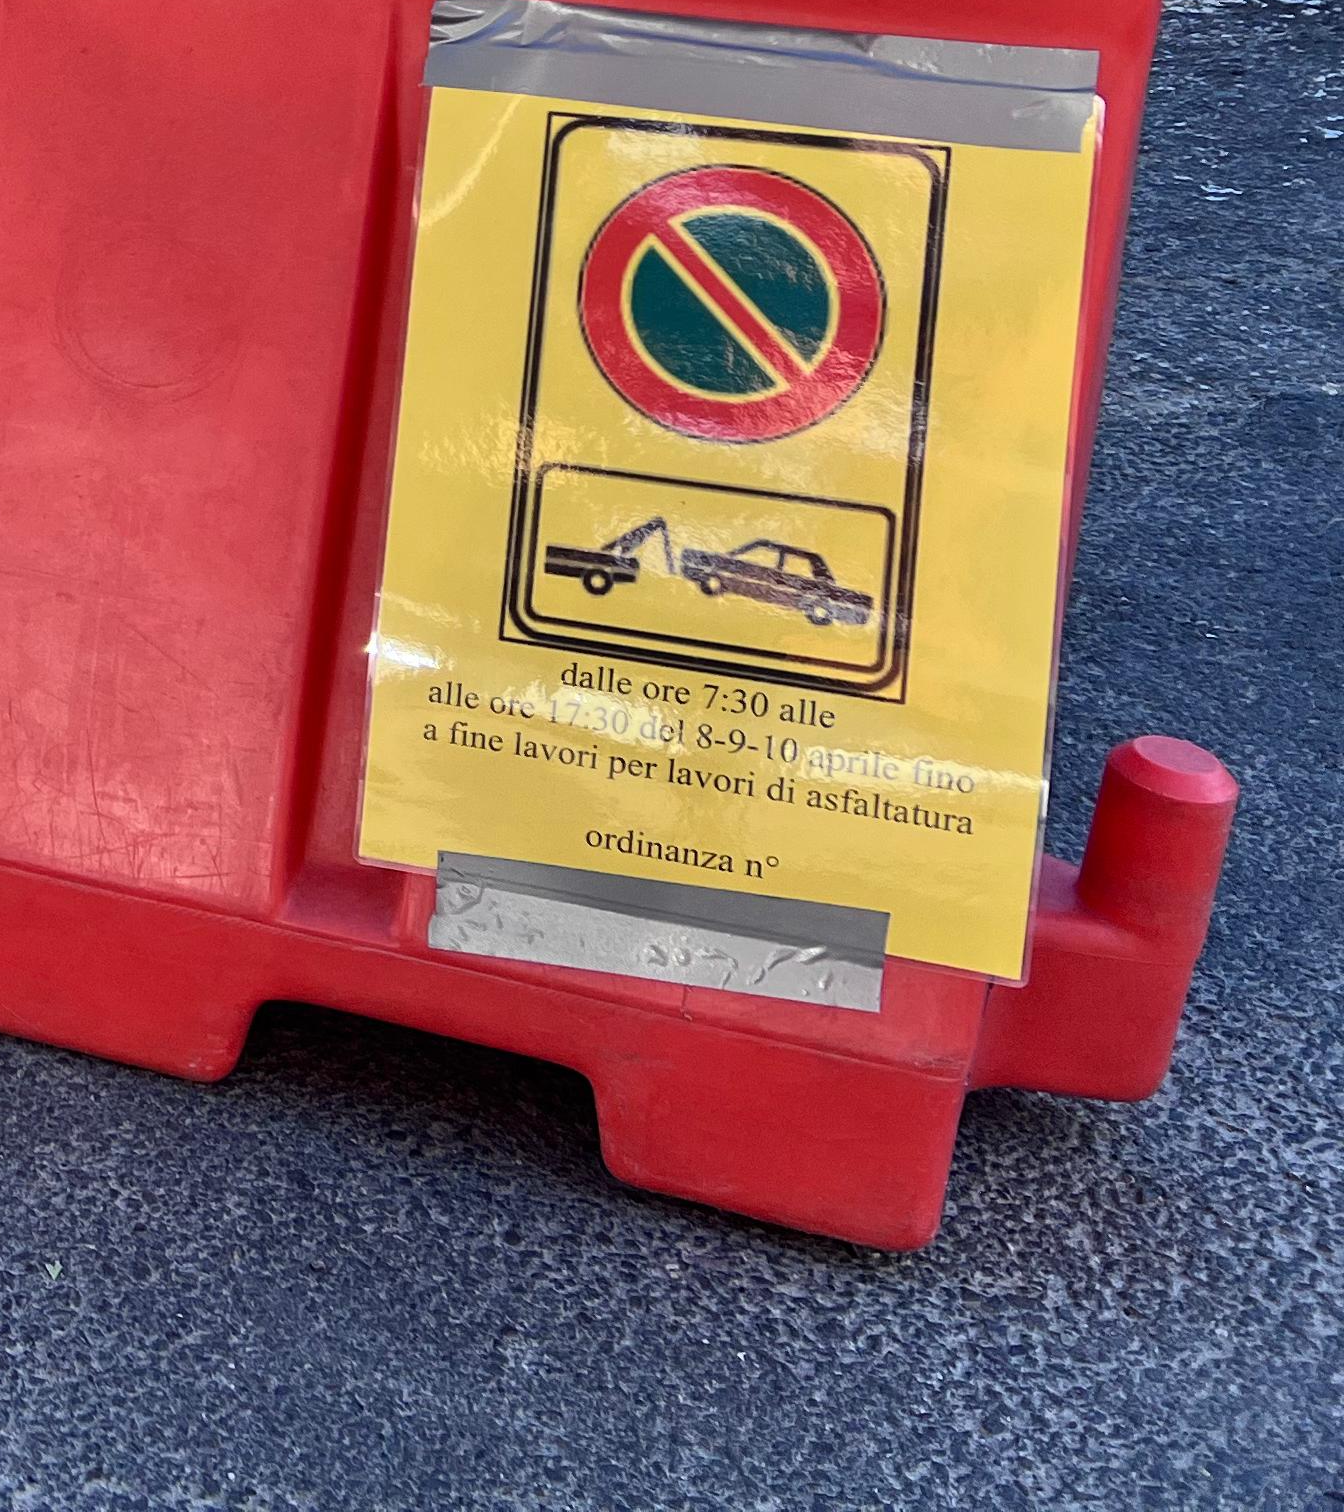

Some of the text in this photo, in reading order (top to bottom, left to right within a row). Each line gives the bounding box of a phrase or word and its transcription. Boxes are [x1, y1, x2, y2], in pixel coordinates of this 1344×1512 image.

[428, 681, 975, 794] alle ore 17:30 del 8-9-10 aprile fino
[561, 662, 835, 728] dalle ore 7:30 alle
[423, 720, 974, 835] a fine lavori per lavori di asfaltatura
[585, 829, 780, 879] ordinanza n°
